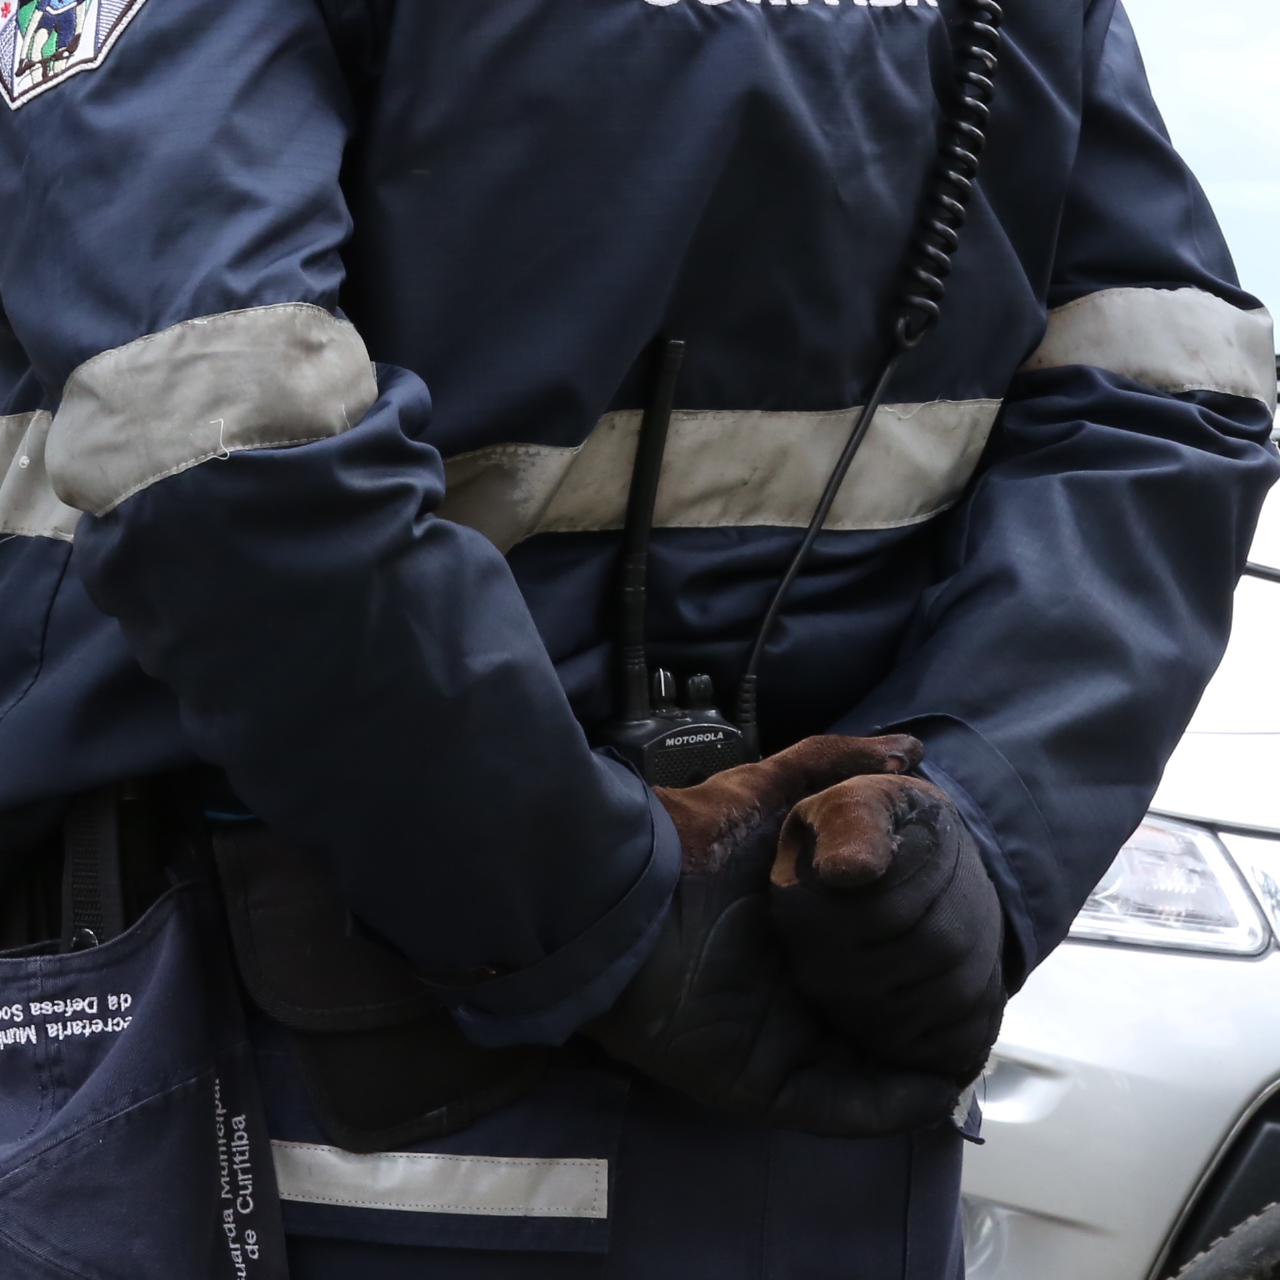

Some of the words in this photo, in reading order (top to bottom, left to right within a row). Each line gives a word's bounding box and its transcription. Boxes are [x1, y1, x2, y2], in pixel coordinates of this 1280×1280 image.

[665, 732, 724, 746] MOTOROLA
[29, 996, 98, 1017] Defesa
[107, 993, 132, 1012] da
[231, 1114, 254, 1214] Curitiba
[223, 1208, 247, 1280] uarda
[244, 1229, 259, 1259] de
